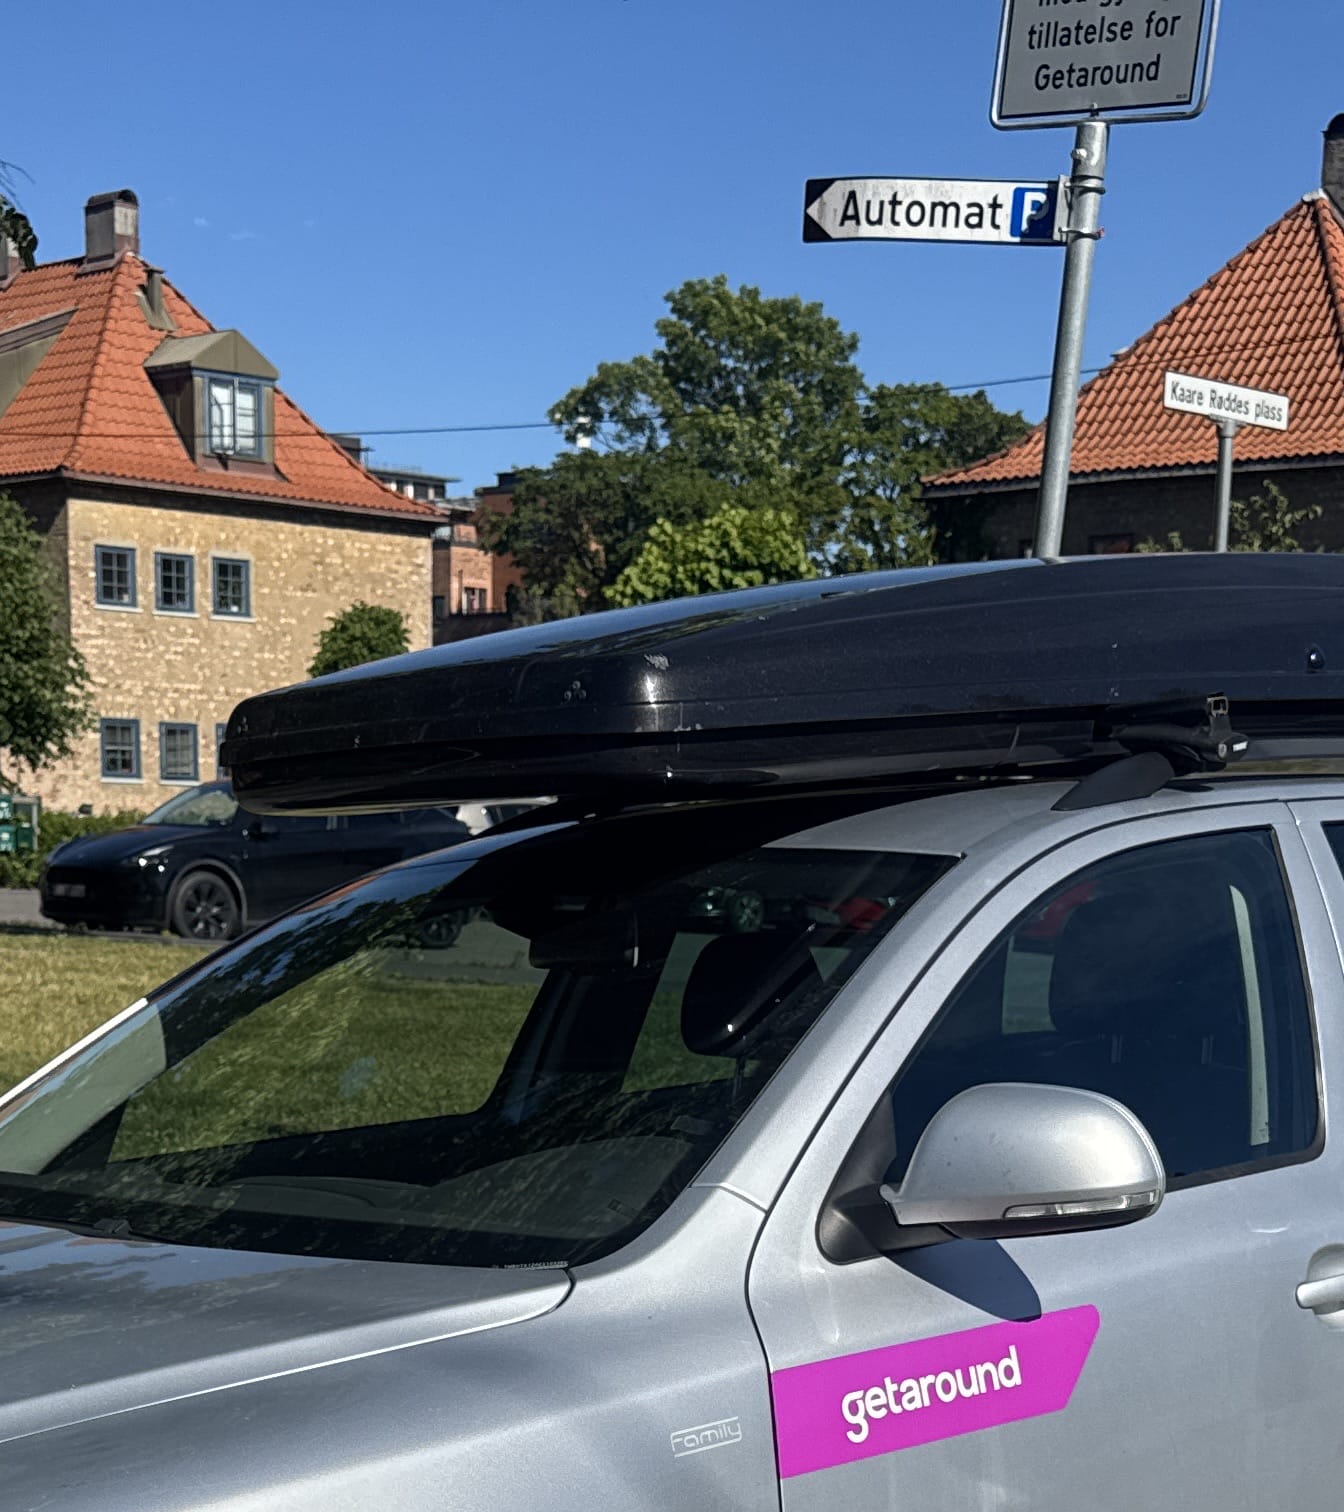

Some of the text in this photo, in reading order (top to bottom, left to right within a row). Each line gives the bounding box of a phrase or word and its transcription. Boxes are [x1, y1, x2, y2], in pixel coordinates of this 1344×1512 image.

[1028, 10, 1181, 50] tillatelse for
[1035, 54, 1161, 91] Getaround
[839, 190, 1003, 230] Automat
[1171, 381, 1204, 406] Kaare
[1255, 400, 1283, 422] plass
[841, 1345, 1022, 1443] getaround
[670, 1416, 743, 1453] Family
